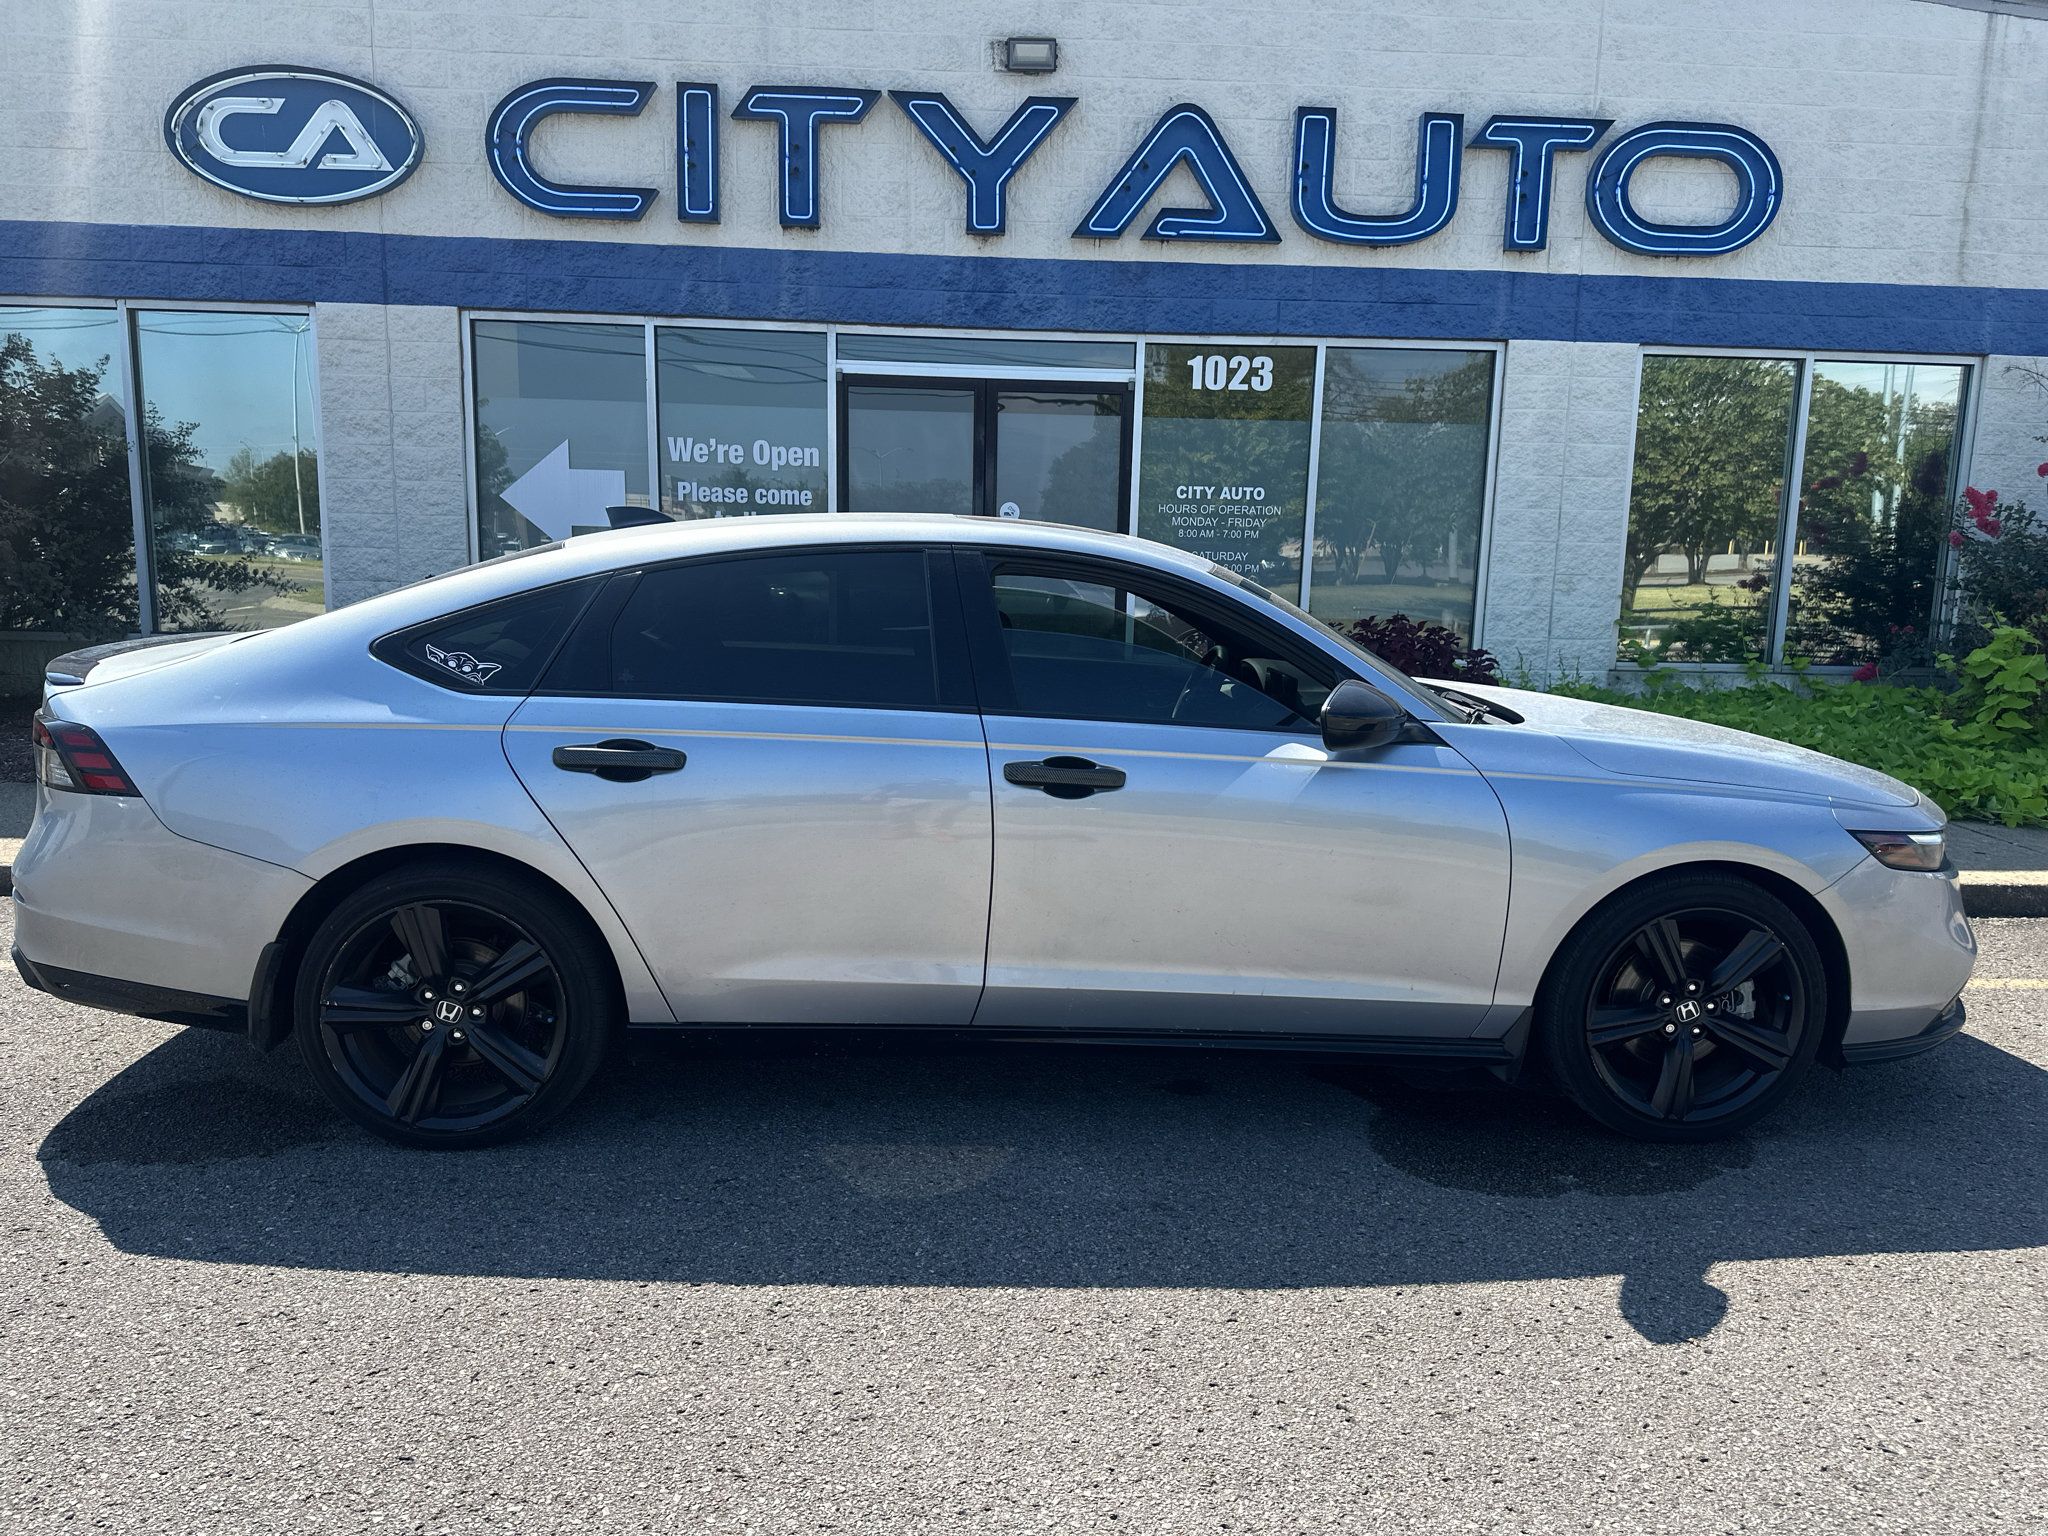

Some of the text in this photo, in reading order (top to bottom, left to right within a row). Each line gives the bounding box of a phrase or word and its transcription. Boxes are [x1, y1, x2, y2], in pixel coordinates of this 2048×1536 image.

[195, 96, 395, 173] CA
[485, 76, 1784, 258] CITY AUTO
[1187, 355, 1274, 392] 1023
[667, 436, 820, 471] We're Open
[677, 481, 813, 506] Please come
[1176, 485, 1266, 501] CITY AUTO
[1158, 504, 1282, 516] HOURS OF OPERATION
[1171, 516, 1219, 527] MONDAY
[1228, 518, 1267, 528] FRIDAY
[1178, 529, 1199, 539] 8:00
[1199, 529, 1214, 539] AM
[1222, 530, 1242, 539] 7:00
[1244, 530, 1259, 539] PM
[1244, 564, 1260, 573] PM
